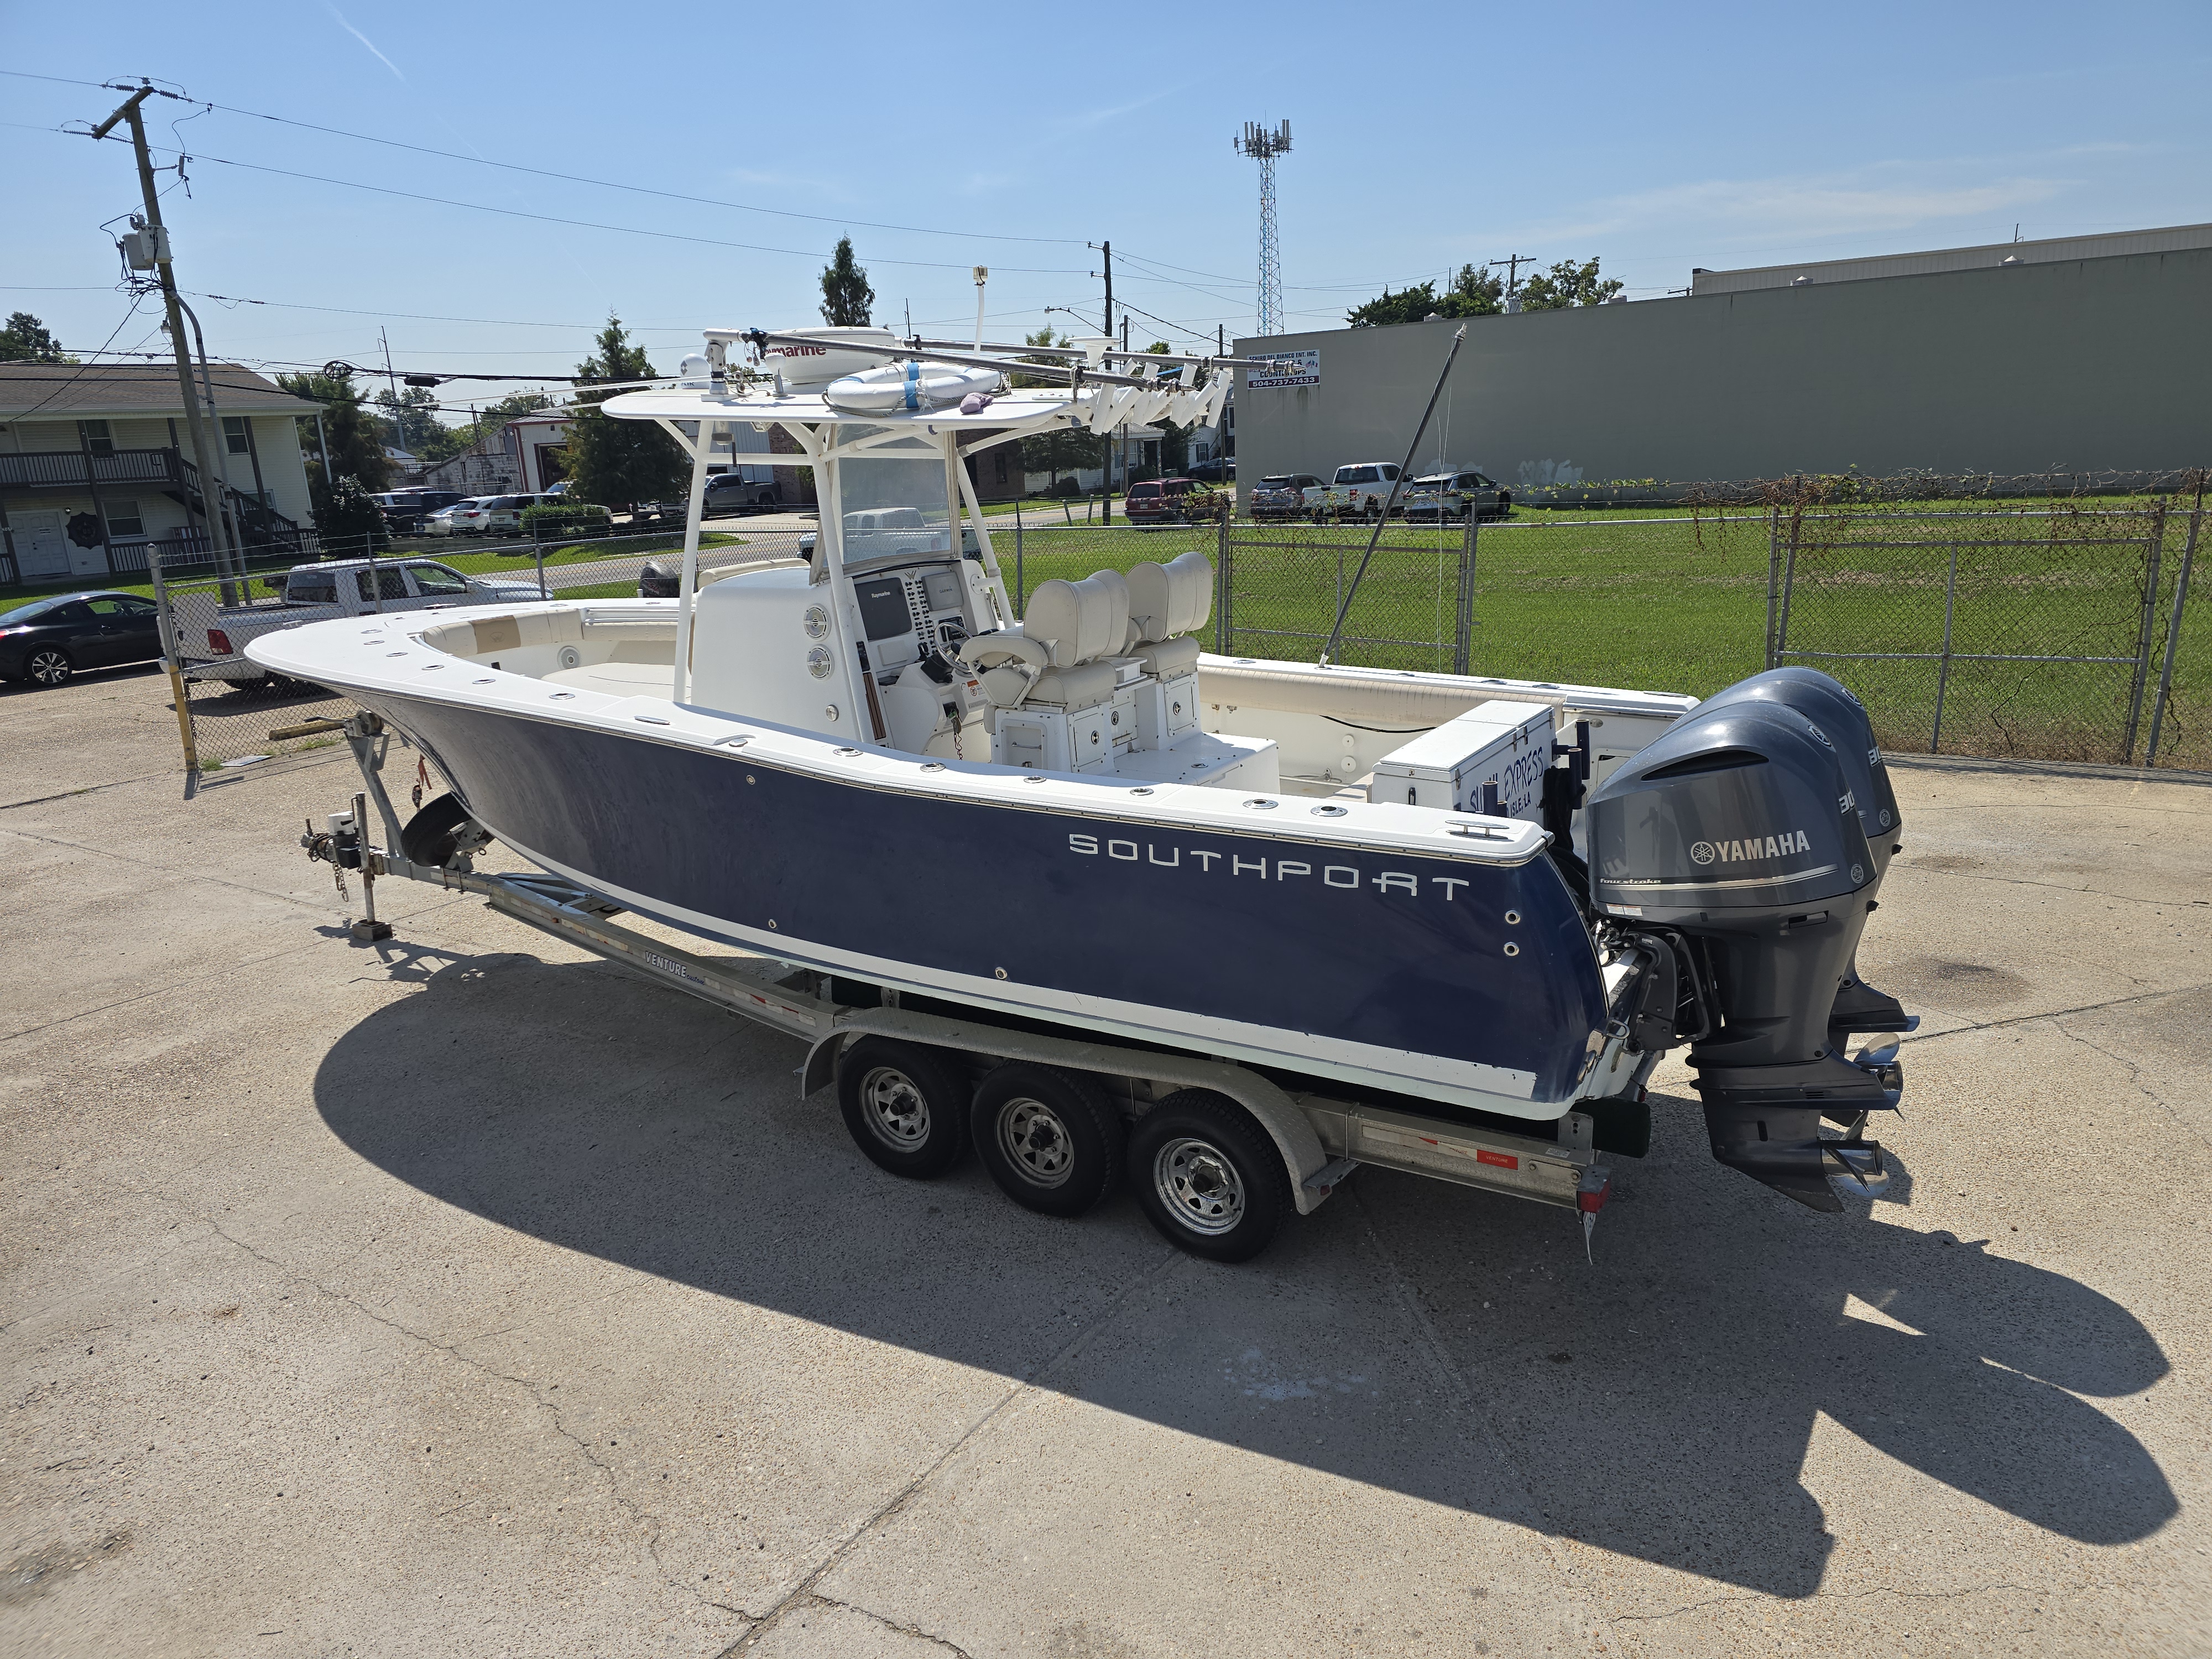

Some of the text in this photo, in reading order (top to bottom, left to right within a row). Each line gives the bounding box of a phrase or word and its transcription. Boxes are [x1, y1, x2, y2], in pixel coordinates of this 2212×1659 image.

[1253, 377, 1315, 387] 504-737-7433
[1504, 746, 1543, 801] EXPRESS
[1510, 791, 1531, 817] ISLE, LA
[1715, 830, 1811, 862] YAMAHA
[1069, 833, 1469, 901] SOUTHPORT
[645, 951, 687, 978] VENTURE
[1486, 1155, 1509, 1164] VENTURE
